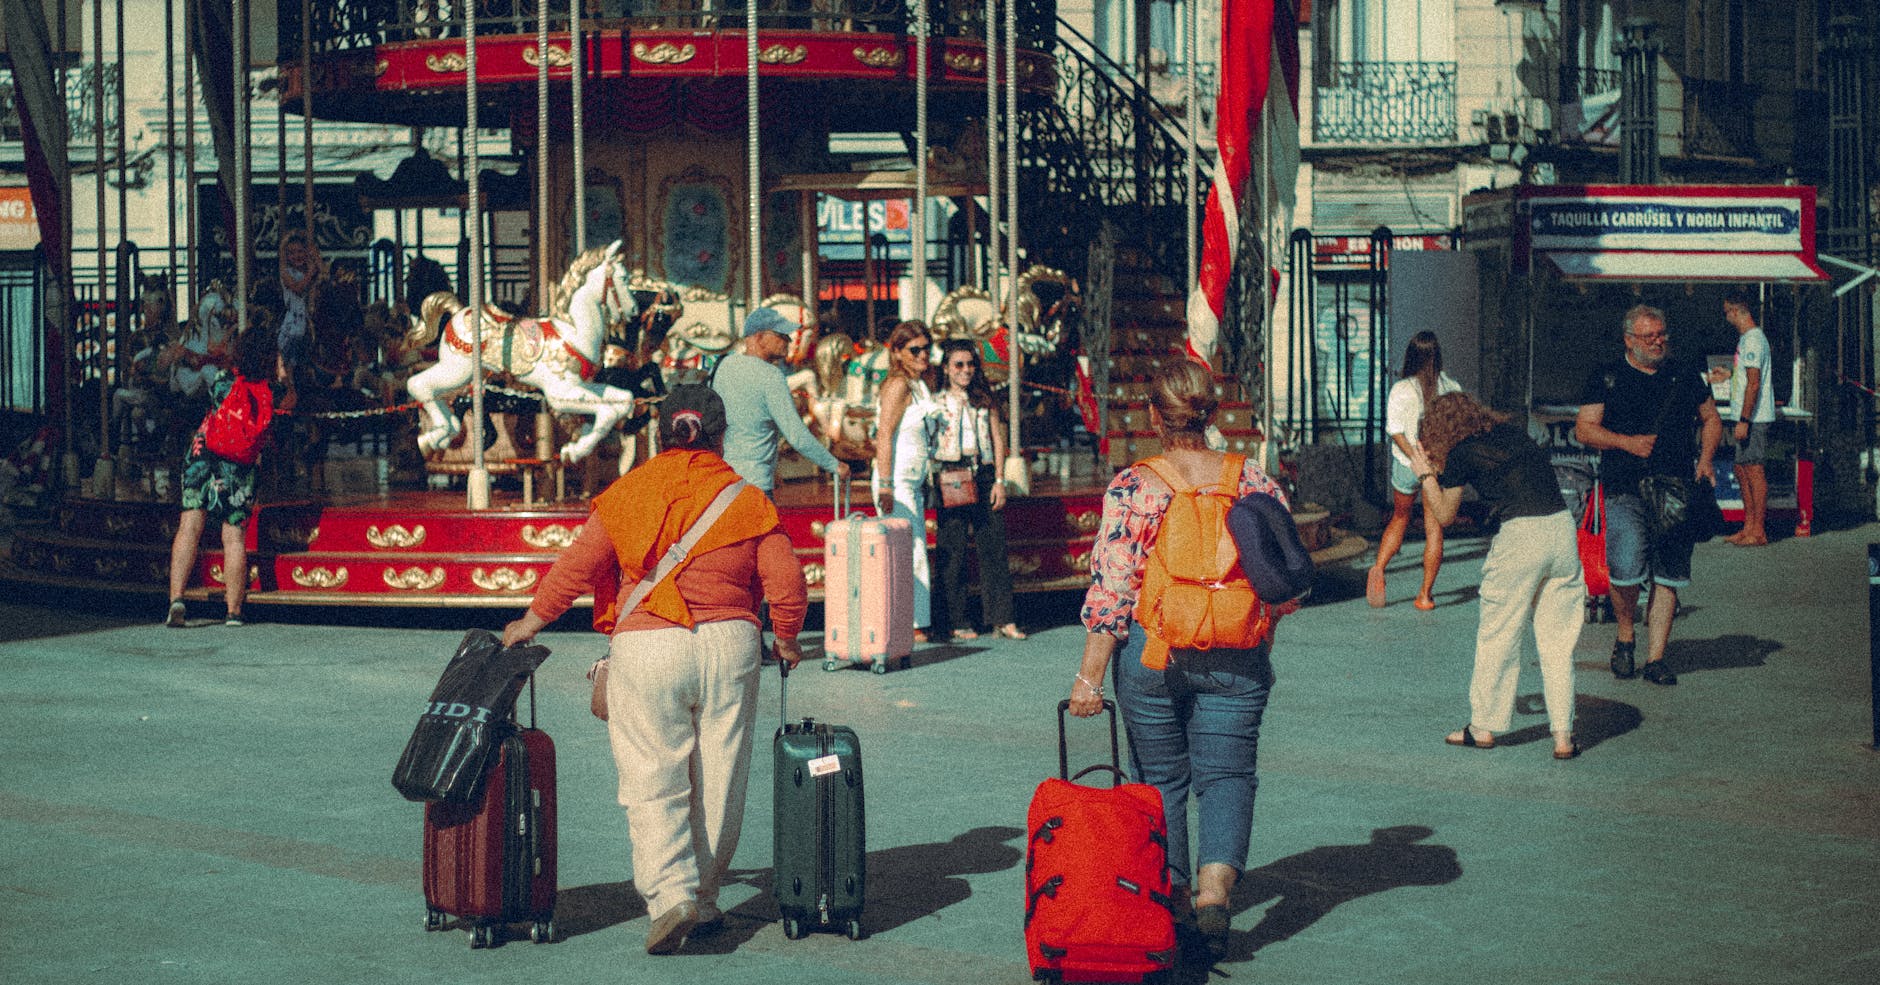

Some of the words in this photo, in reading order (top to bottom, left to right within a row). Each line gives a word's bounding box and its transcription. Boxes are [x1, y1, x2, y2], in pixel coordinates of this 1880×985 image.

[1551, 212, 1609, 228] TAQUILLA
[1676, 212, 1684, 228] Y
[1687, 212, 1725, 228] NORIA
[1728, 212, 1785, 229] INFANTIL
